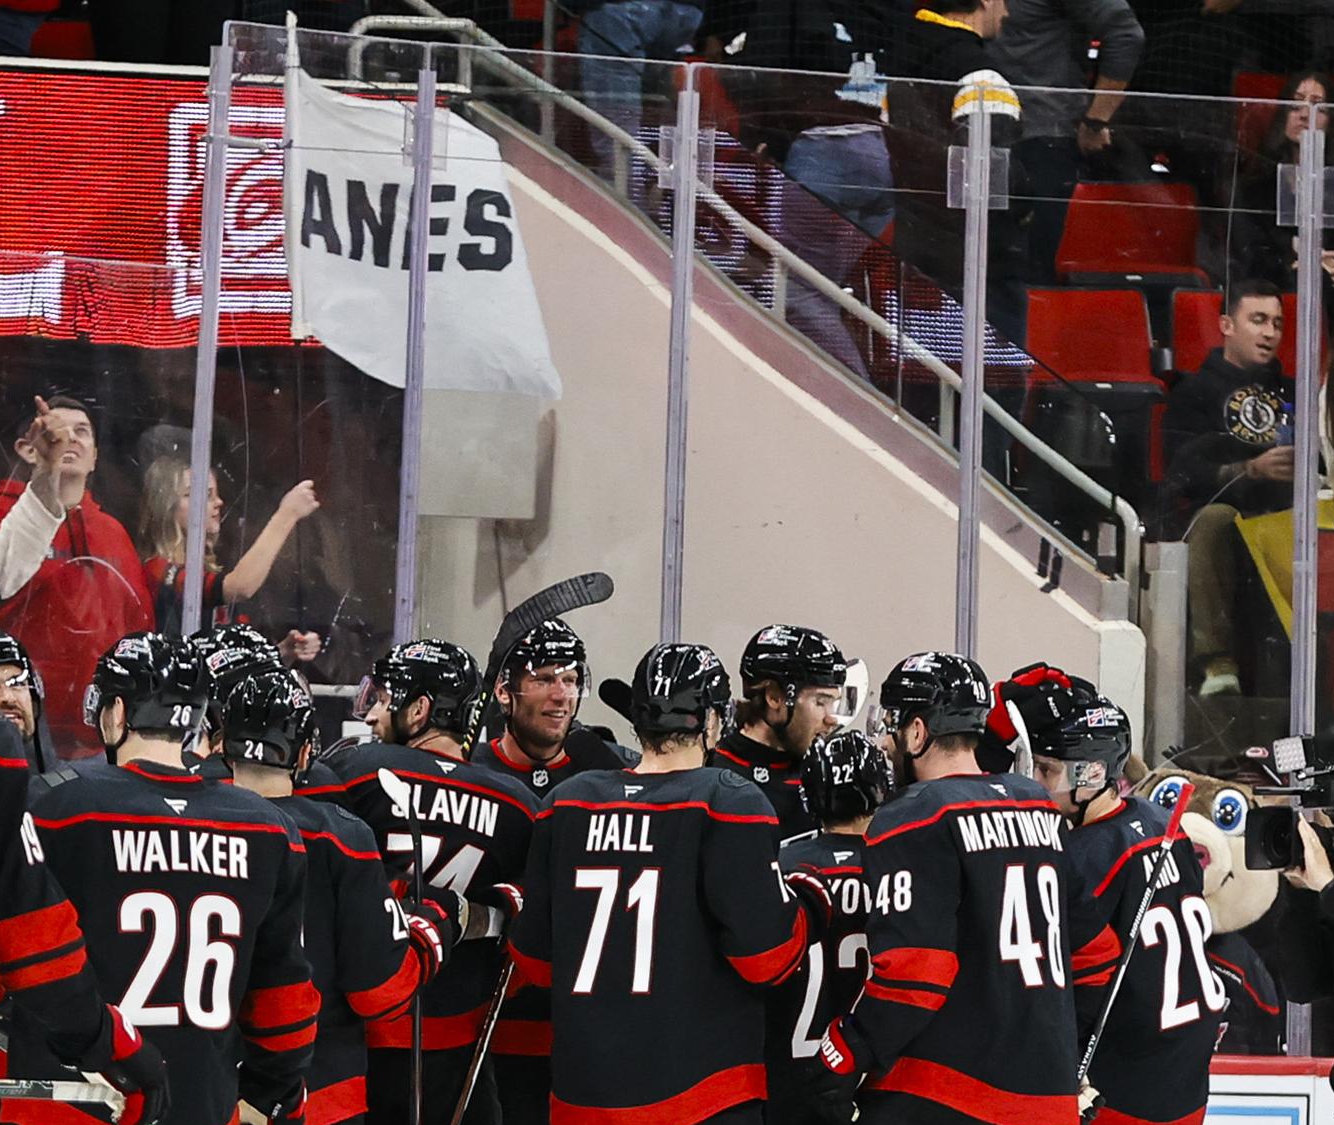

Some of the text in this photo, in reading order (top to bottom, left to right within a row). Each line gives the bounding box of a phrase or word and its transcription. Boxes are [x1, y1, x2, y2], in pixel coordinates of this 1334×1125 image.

[654, 675, 671, 697] 71
[170, 704, 193, 728] 26
[244, 739, 264, 761] 24
[832, 764, 853, 785] 22
[20, 810, 44, 864] 19
[112, 829, 248, 879] WALKER
[586, 813, 653, 853] HALL
[957, 811, 1064, 853] MARTINOK
[876, 871, 912, 915] 48
[572, 867, 660, 995] 71
[999, 865, 1066, 989] 48
[118, 891, 242, 1029] 26
[1140, 896, 1227, 1031] 20
